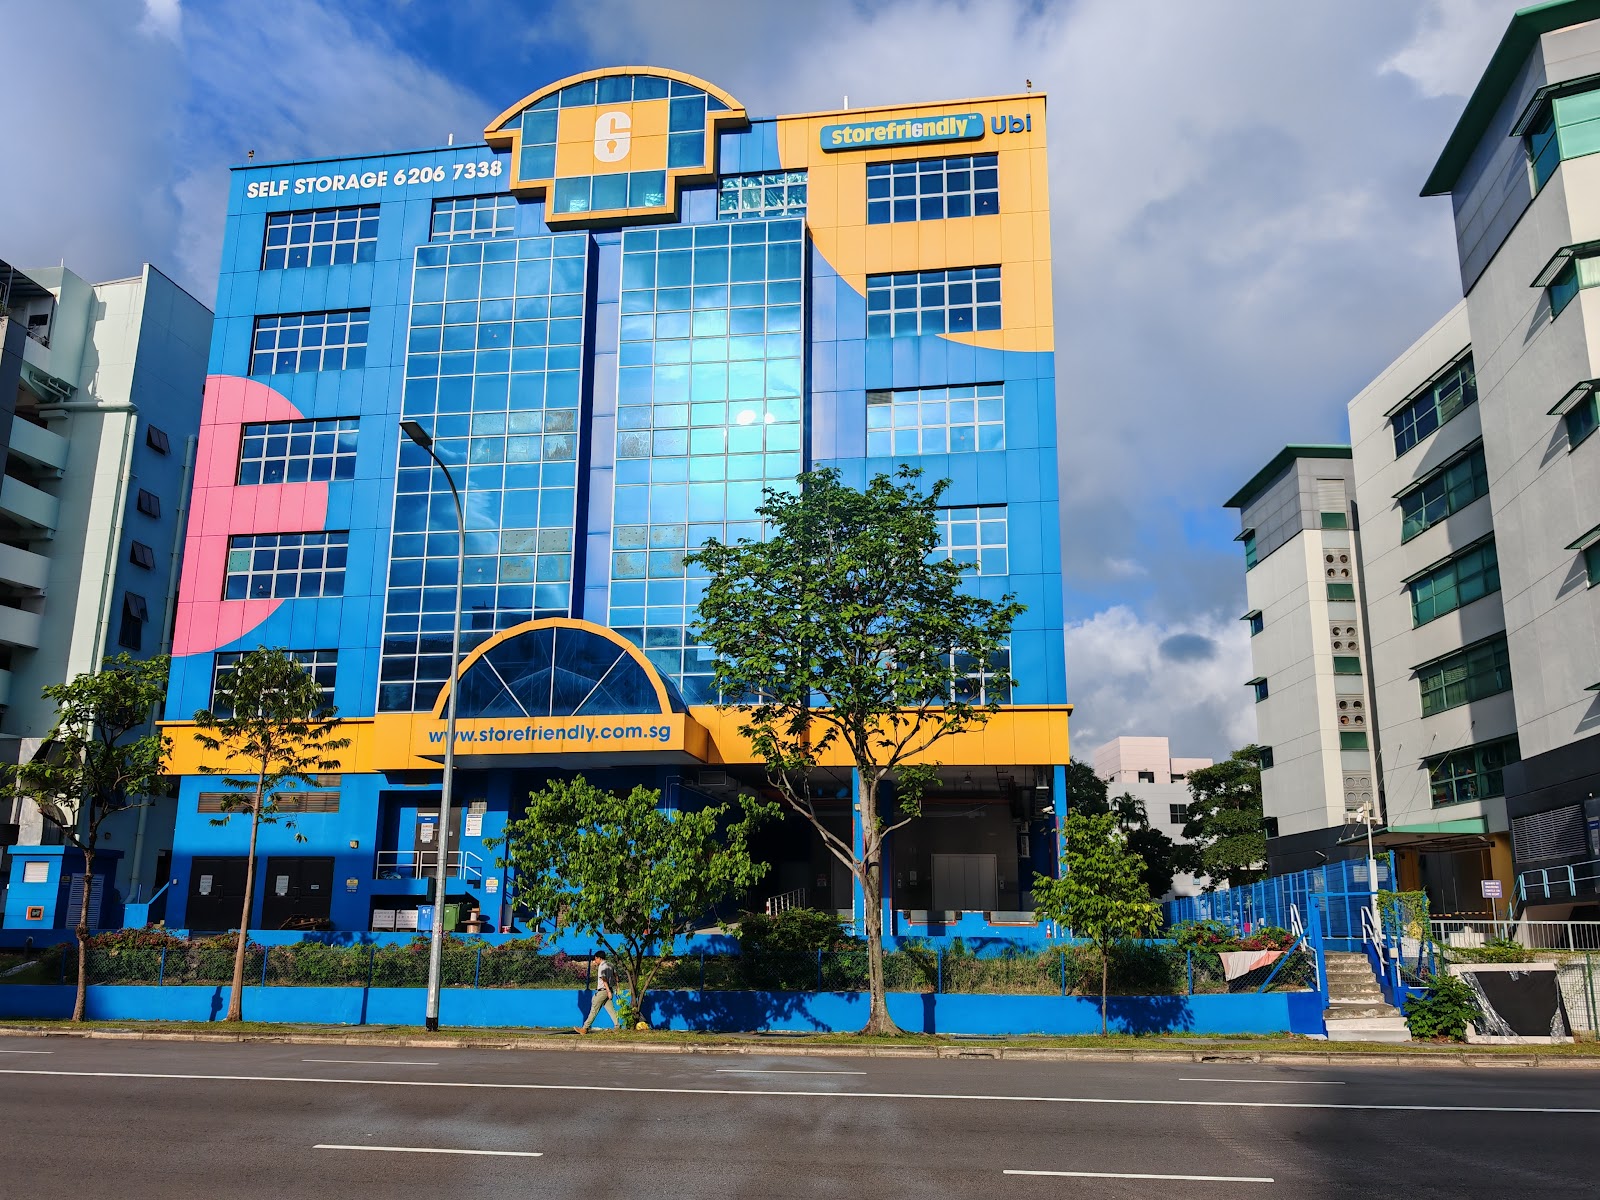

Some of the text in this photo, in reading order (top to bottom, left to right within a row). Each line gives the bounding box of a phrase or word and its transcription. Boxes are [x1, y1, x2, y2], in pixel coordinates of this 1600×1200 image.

[991, 114, 1032, 134] Ubi
[247, 160, 502, 199] SELF STORAGE 6206 7338
